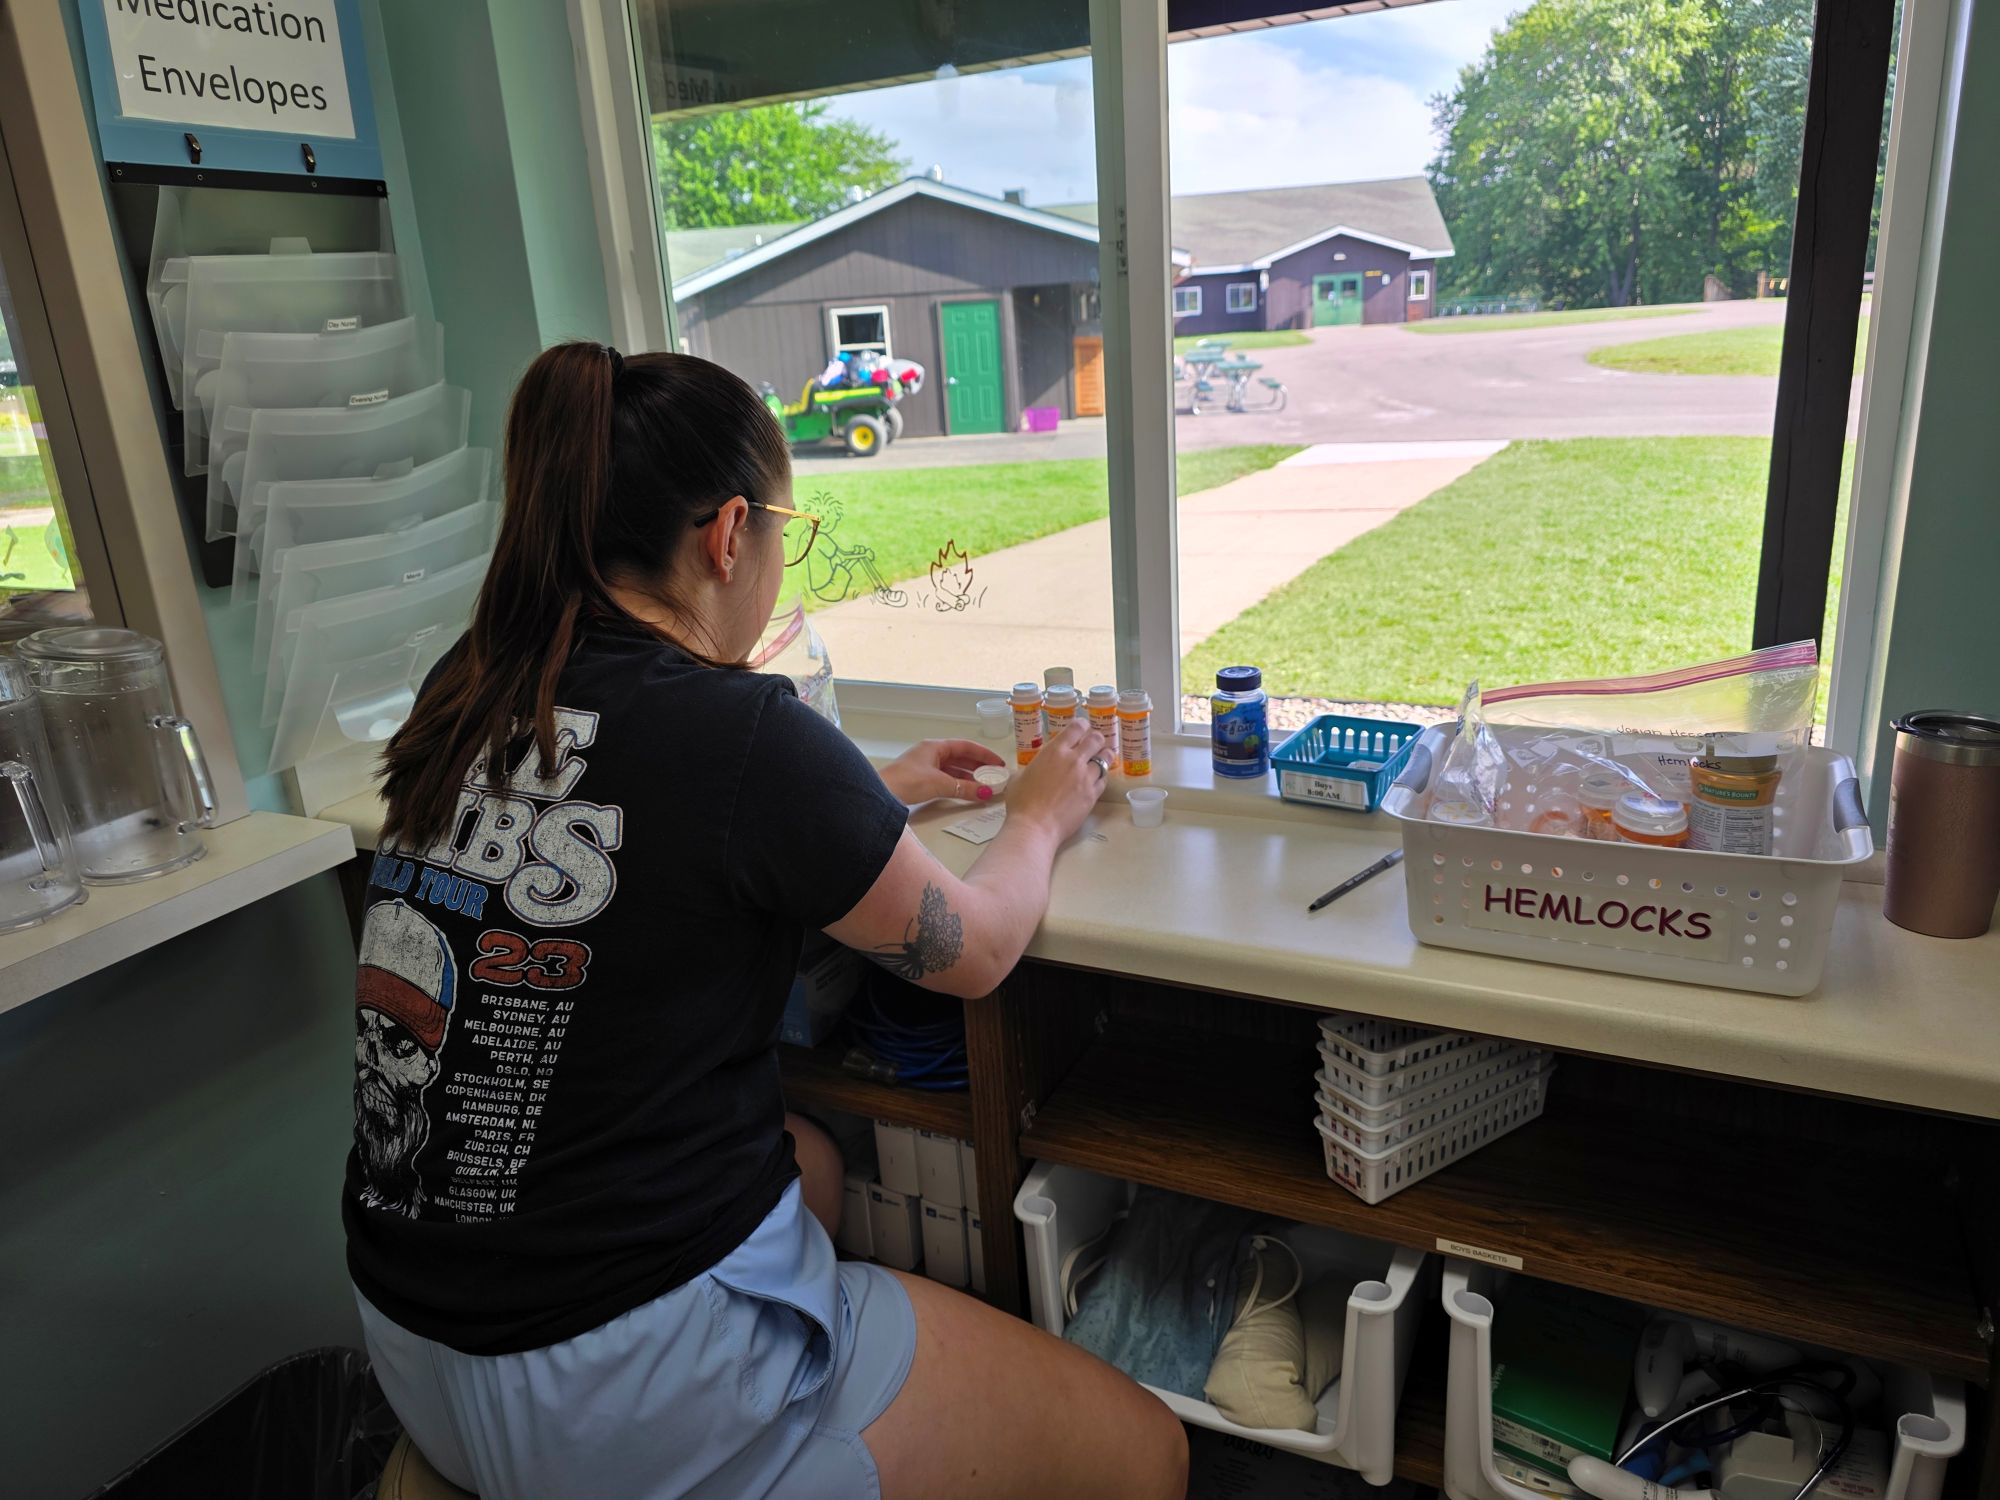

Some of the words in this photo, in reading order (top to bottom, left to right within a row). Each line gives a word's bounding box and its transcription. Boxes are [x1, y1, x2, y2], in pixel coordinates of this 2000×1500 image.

[138, 54, 328, 114] Envelopes
[1657, 755, 1722, 769] Hemlocks
[1315, 781, 1333, 790] Boys
[1325, 791, 1340, 800] AM
[415, 867, 489, 920] TOUR
[1484, 884, 1712, 940] HEMLOCKS
[469, 929, 592, 990] 23
[481, 994, 550, 1011] BRISBANE,
[555, 1002, 574, 1011] AU
[493, 1010, 546, 1024] SYDNEY,
[551, 1014, 570, 1024] AU
[464, 1019, 542, 1038] MELBOURNE,
[547, 1028, 566, 1038] AU
[472, 1034, 538, 1050] ADELAIDE,
[544, 1041, 562, 1050] AU
[490, 1051, 534, 1064] PERTH,
[540, 1054, 558, 1064] AU
[496, 1065, 531, 1076] OSLO,
[536, 1067, 554, 1076] NO
[454, 1072, 527, 1090] STOCKHOLM,
[532, 1079, 551, 1089] SE
[445, 1084, 524, 1102] COPENHAGEN,
[529, 1093, 547, 1102] DK
[462, 1100, 521, 1115] HAMBURG,
[525, 1105, 543, 1115] DE
[445, 1112, 517, 1130] AMSTERDAM,
[522, 1119, 538, 1129] NL
[474, 1129, 513, 1141] PARIS,
[518, 1132, 535, 1141] FR
[464, 1140, 509, 1155] ZURICH,
[514, 1145, 531, 1155] CH
[447, 1150, 505, 1169] BRUSSELS,
[509, 1159, 528, 1169] BE
[455, 1166, 500, 1177] DUBLIN,
[448, 1186, 497, 1199] GLASGOW,
[501, 1189, 517, 1199] UK
[434, 1195, 495, 1214] MANCHESTER,
[499, 1202, 516, 1213] UK
[1450, 1244, 1471, 1254] BOYS
[1472, 1250, 1508, 1263] BASKETS
